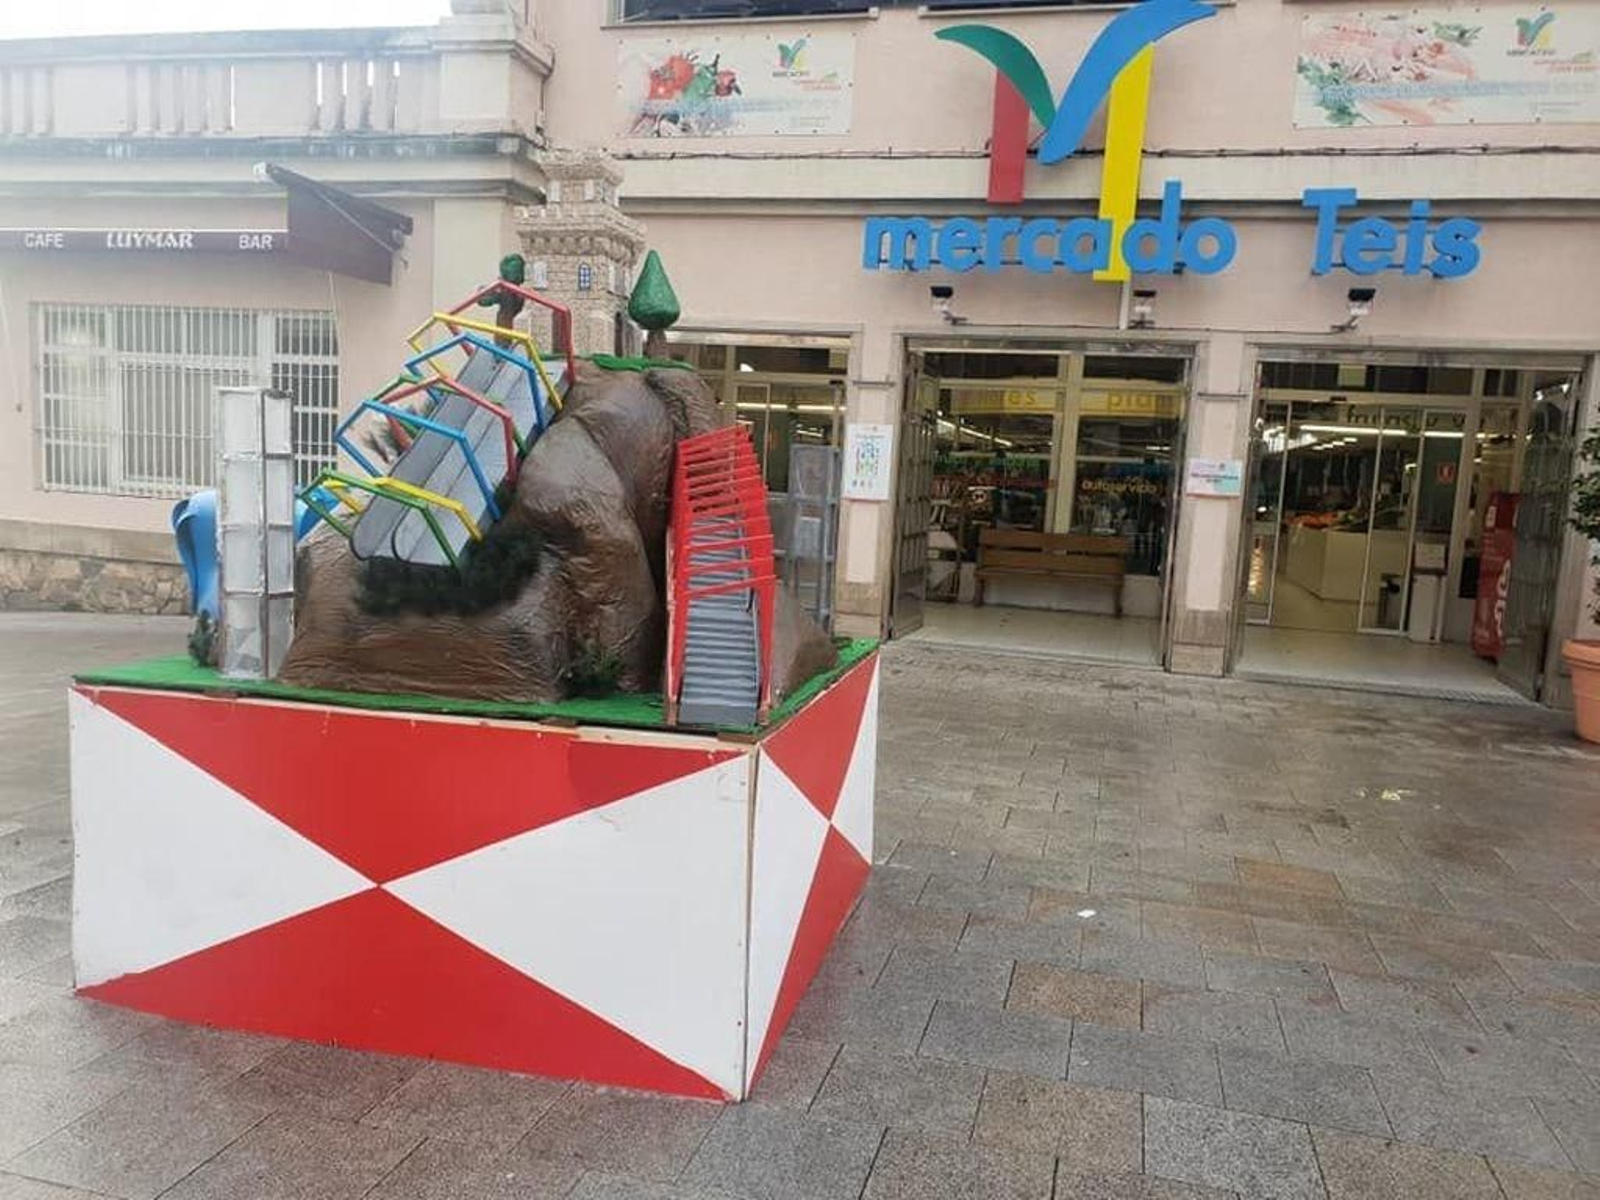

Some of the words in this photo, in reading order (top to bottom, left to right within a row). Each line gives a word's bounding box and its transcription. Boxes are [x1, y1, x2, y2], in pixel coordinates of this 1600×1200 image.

[106, 231, 194, 249] LUYMAR
[238, 233, 273, 250] BAR
[862, 181, 1237, 274] mercado
[1302, 187, 1481, 278] Teis
